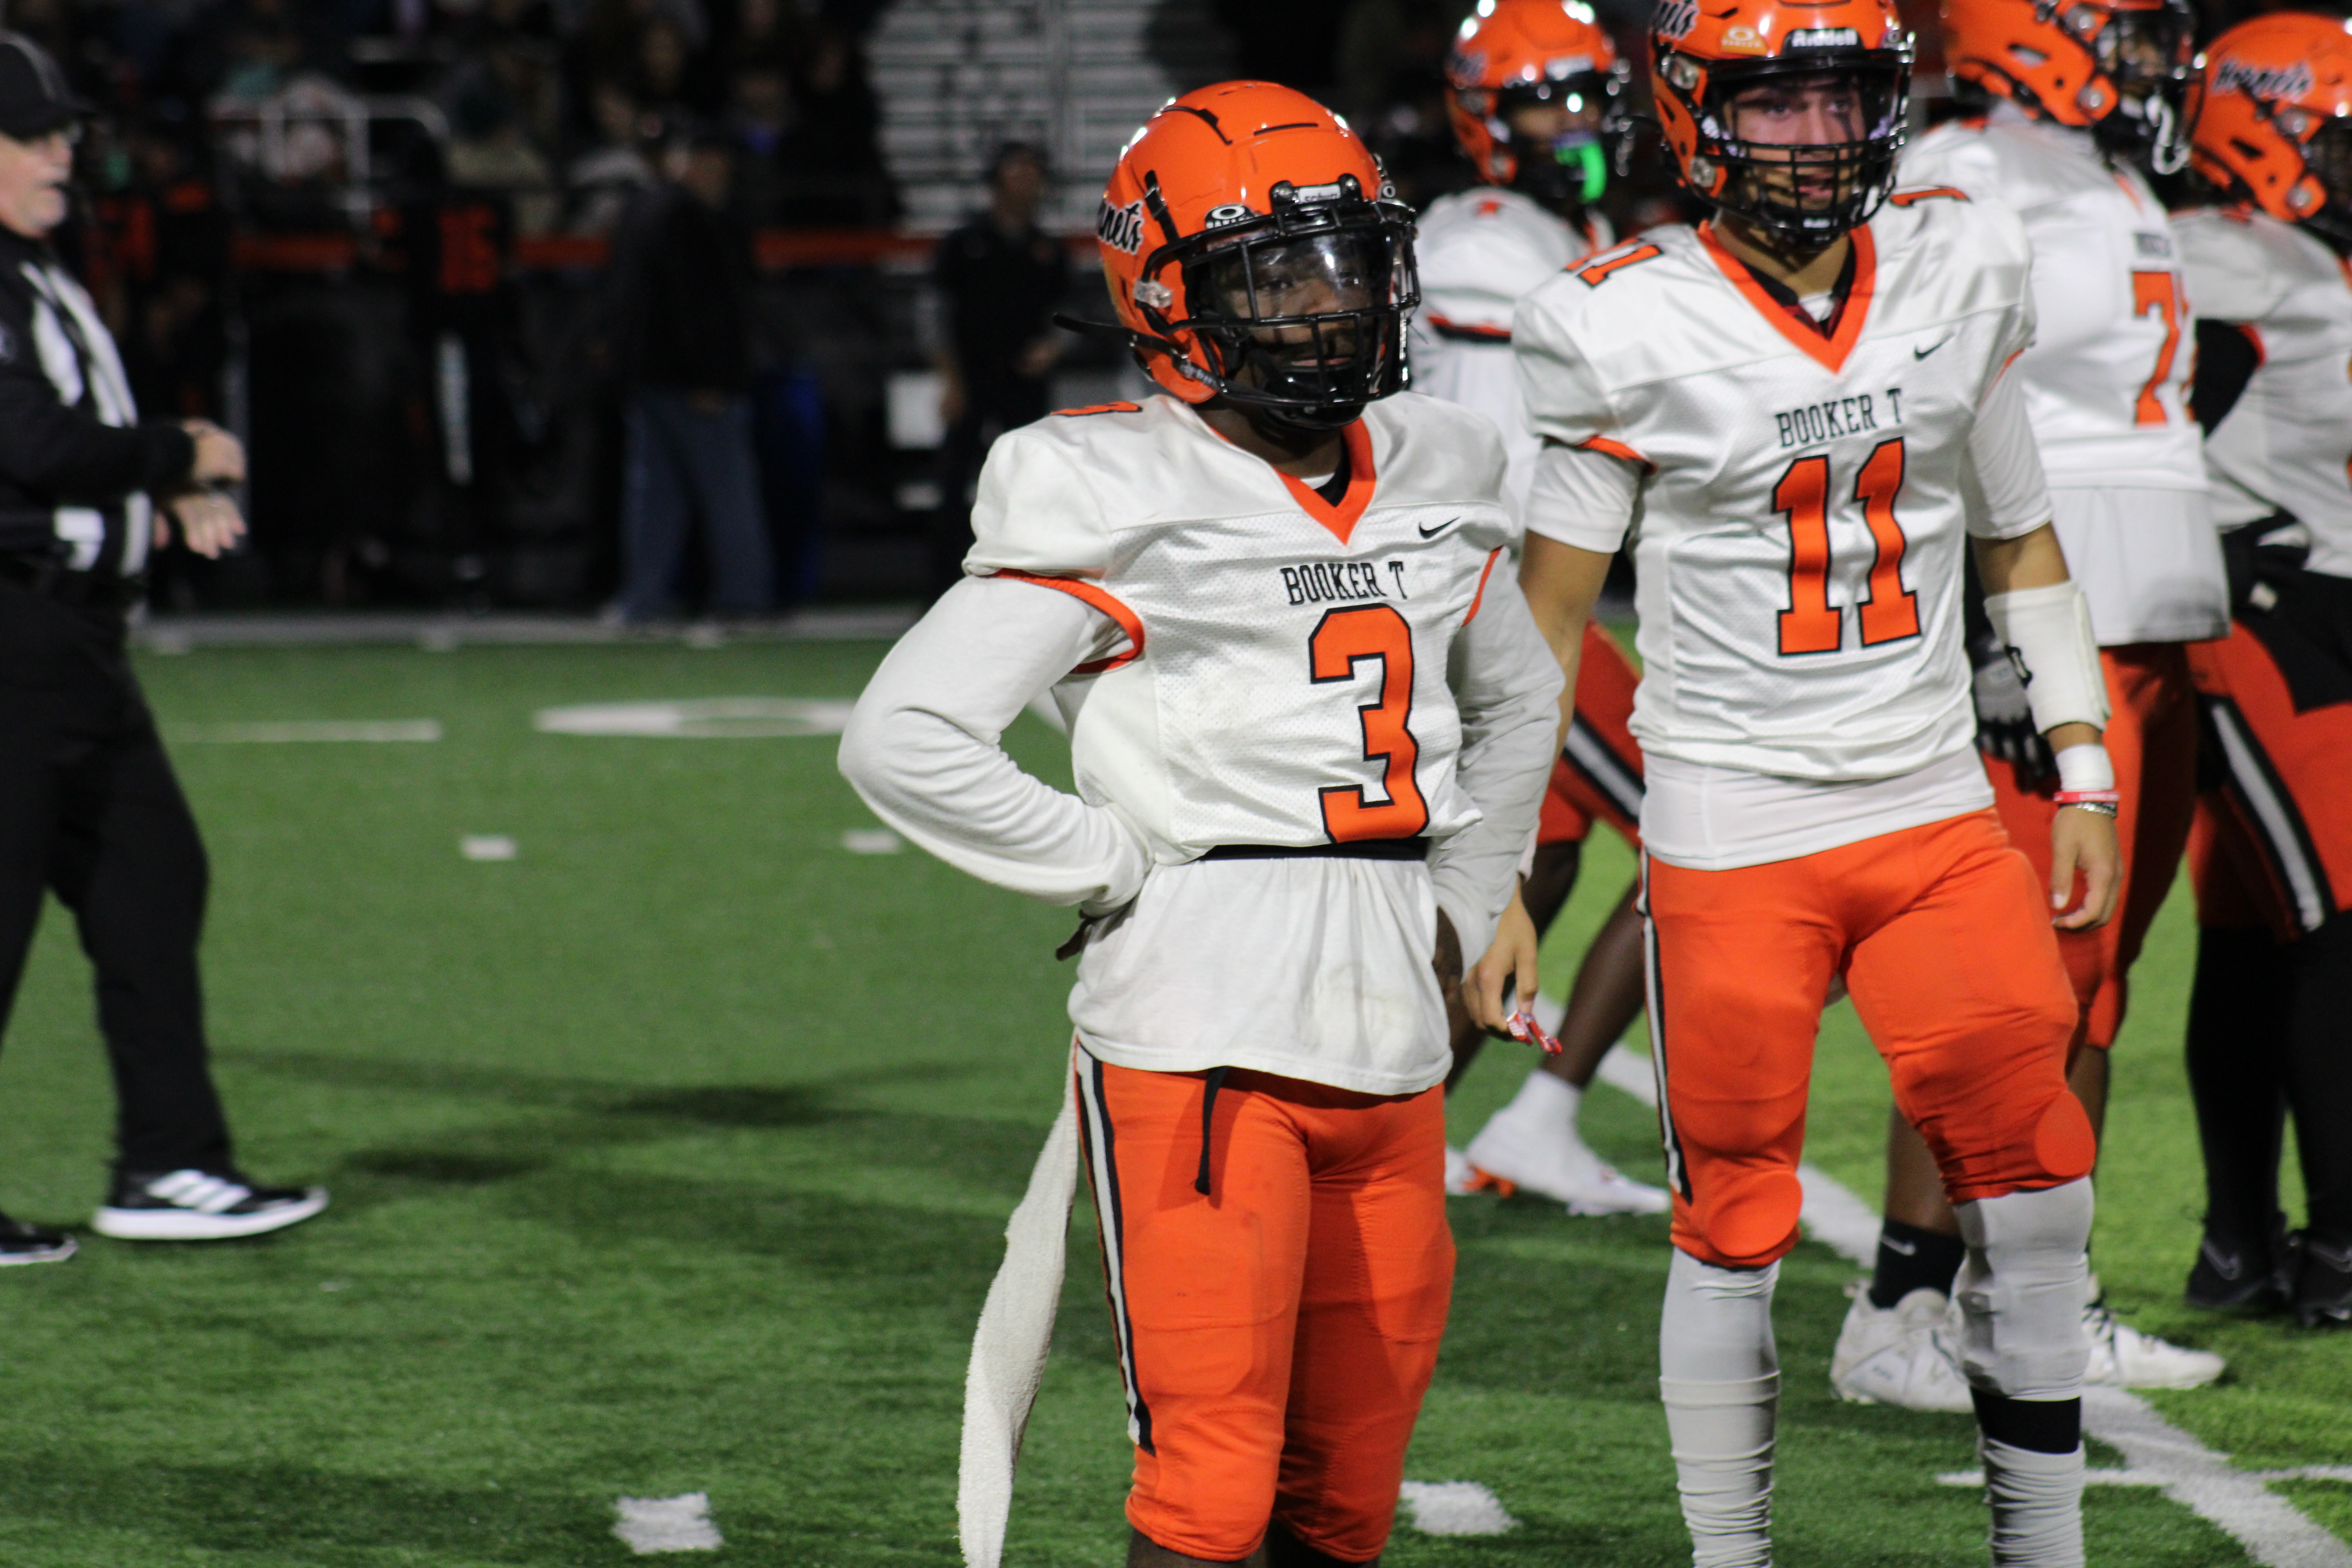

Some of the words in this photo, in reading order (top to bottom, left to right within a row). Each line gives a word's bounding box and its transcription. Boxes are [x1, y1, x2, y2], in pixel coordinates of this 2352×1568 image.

[1774, 394, 1878, 448] BOOKER
[1886, 387, 1902, 424] T
[2130, 270, 2200, 428] 7
[1279, 562, 1387, 606] BOOKER
[1388, 561, 1408, 600] T
[1770, 436, 1923, 657] 11
[1308, 602, 1430, 844] 3
